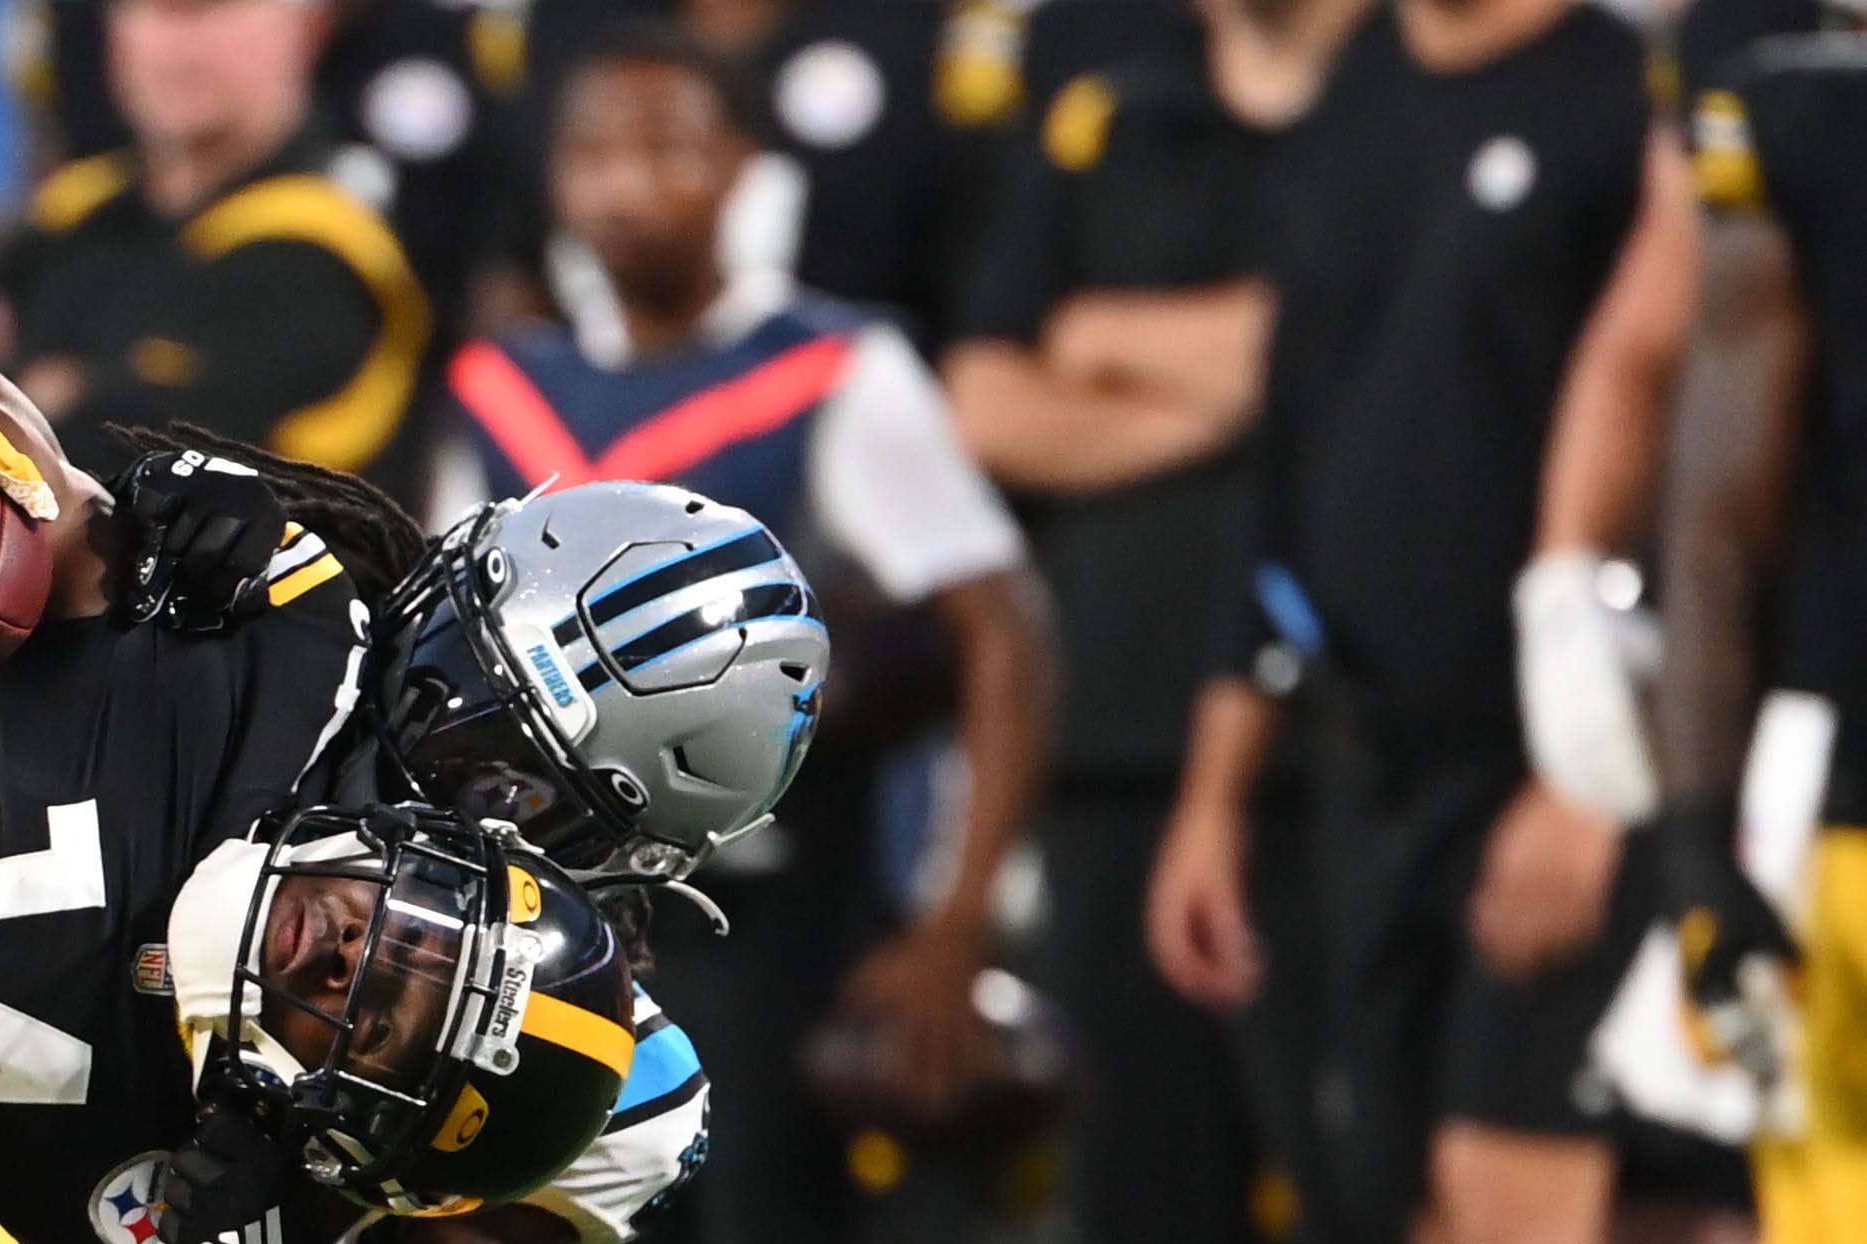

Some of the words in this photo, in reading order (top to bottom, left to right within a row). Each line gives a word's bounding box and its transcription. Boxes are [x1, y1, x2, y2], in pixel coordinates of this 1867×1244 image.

[526, 643, 575, 709] PANTHERS
[137, 951, 165, 989] NFL
[491, 967, 527, 1039] Steelers
